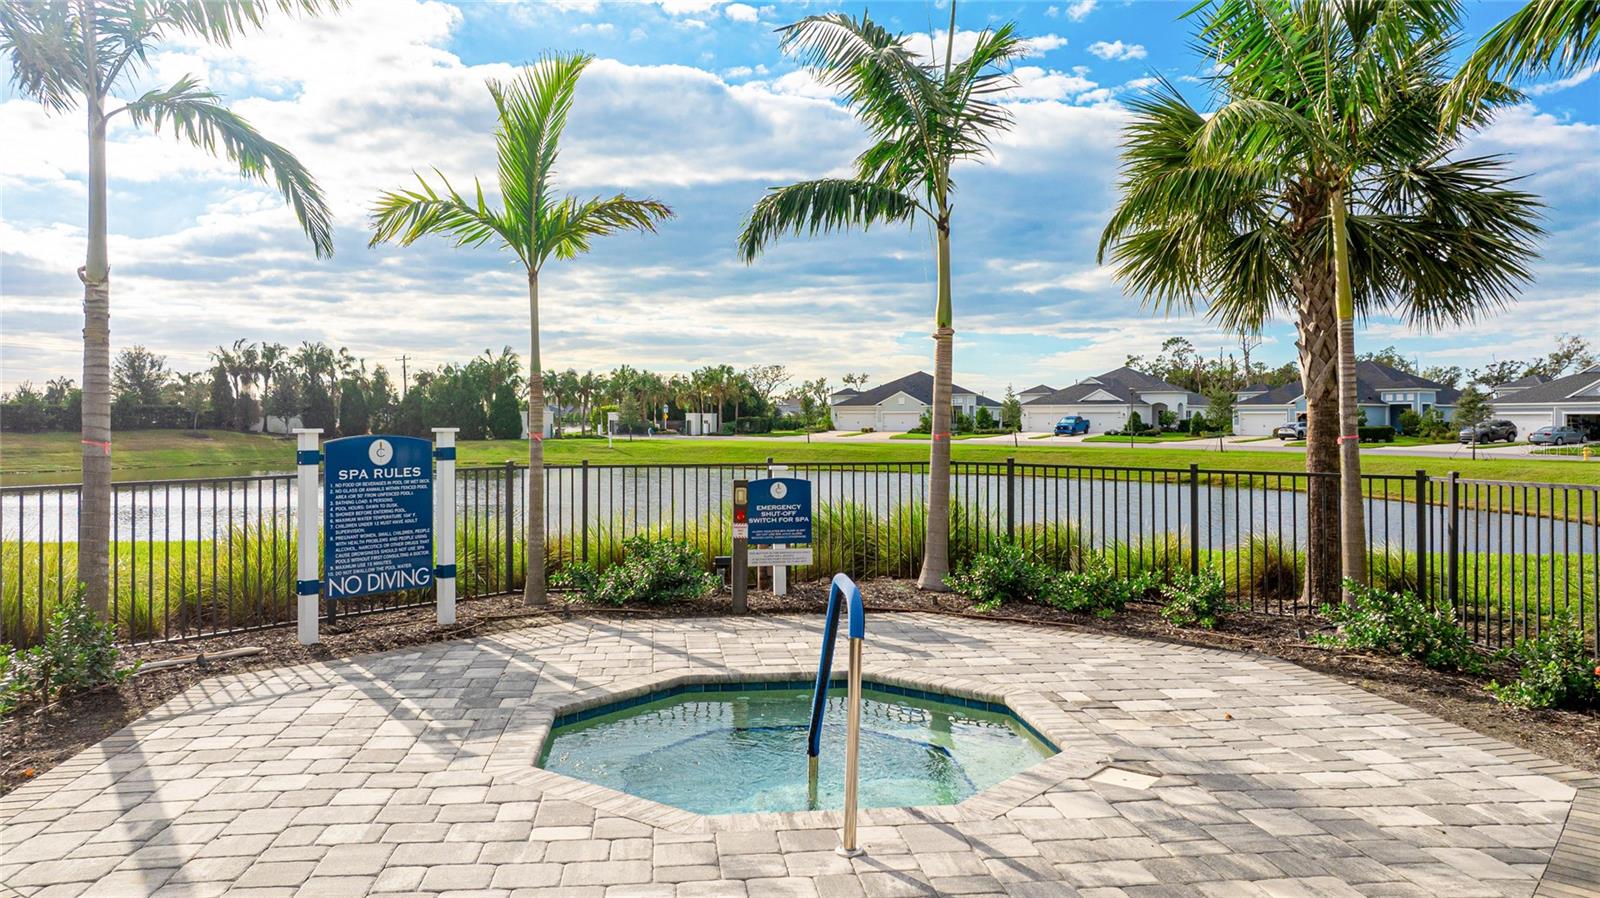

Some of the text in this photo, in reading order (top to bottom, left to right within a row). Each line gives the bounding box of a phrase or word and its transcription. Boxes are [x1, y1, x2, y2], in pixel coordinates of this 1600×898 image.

[338, 467, 421, 480] SPA RULES
[329, 568, 430, 596] NO DIVING
